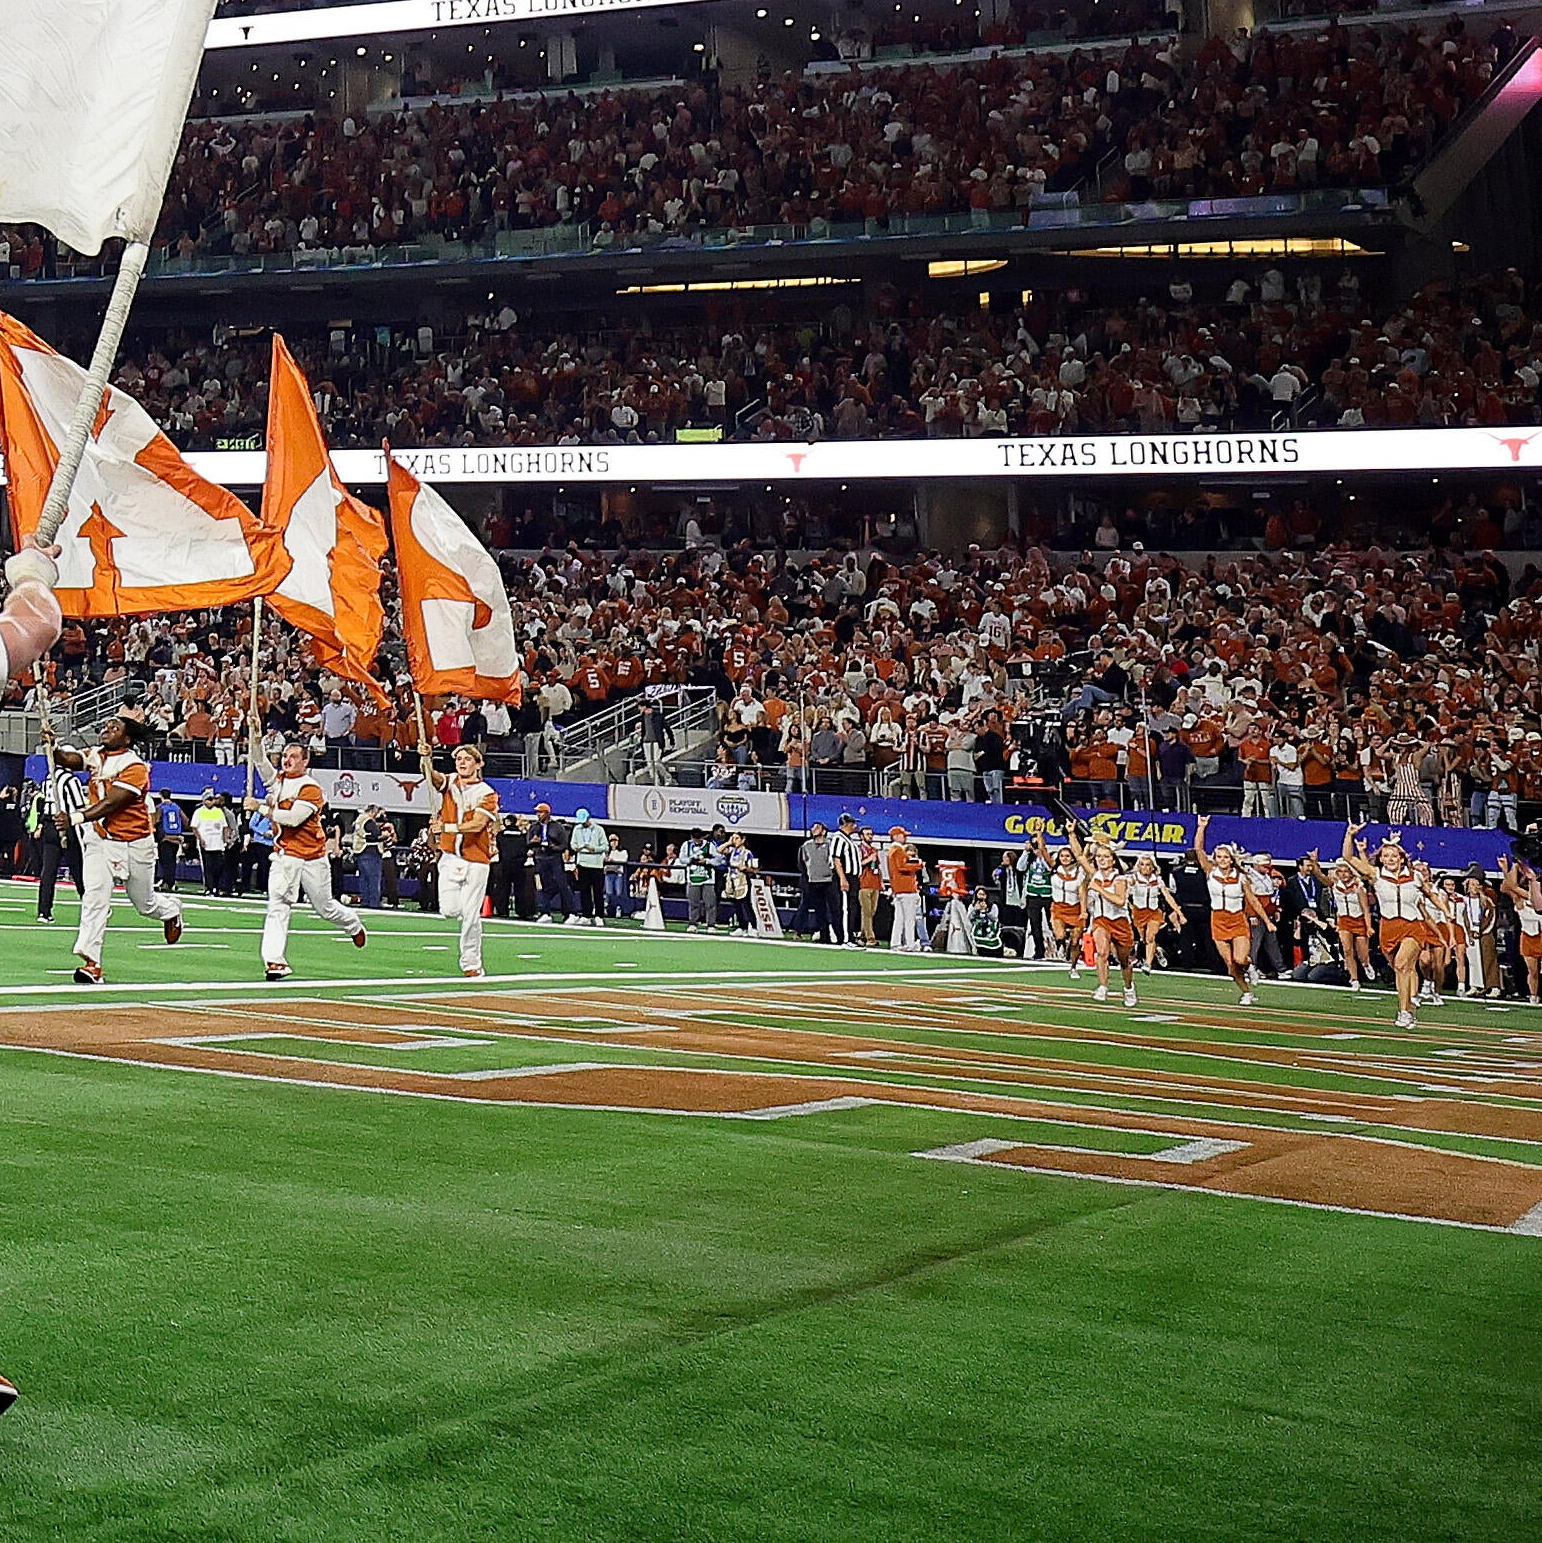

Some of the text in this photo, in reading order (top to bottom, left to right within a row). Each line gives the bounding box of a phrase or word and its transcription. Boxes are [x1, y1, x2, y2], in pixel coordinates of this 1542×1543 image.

[374, 452, 609, 475] TXAS LONGHORNS
[997, 438, 1299, 467] TEXAS LONGHORNS
[753, 884, 776, 932] NOISE
